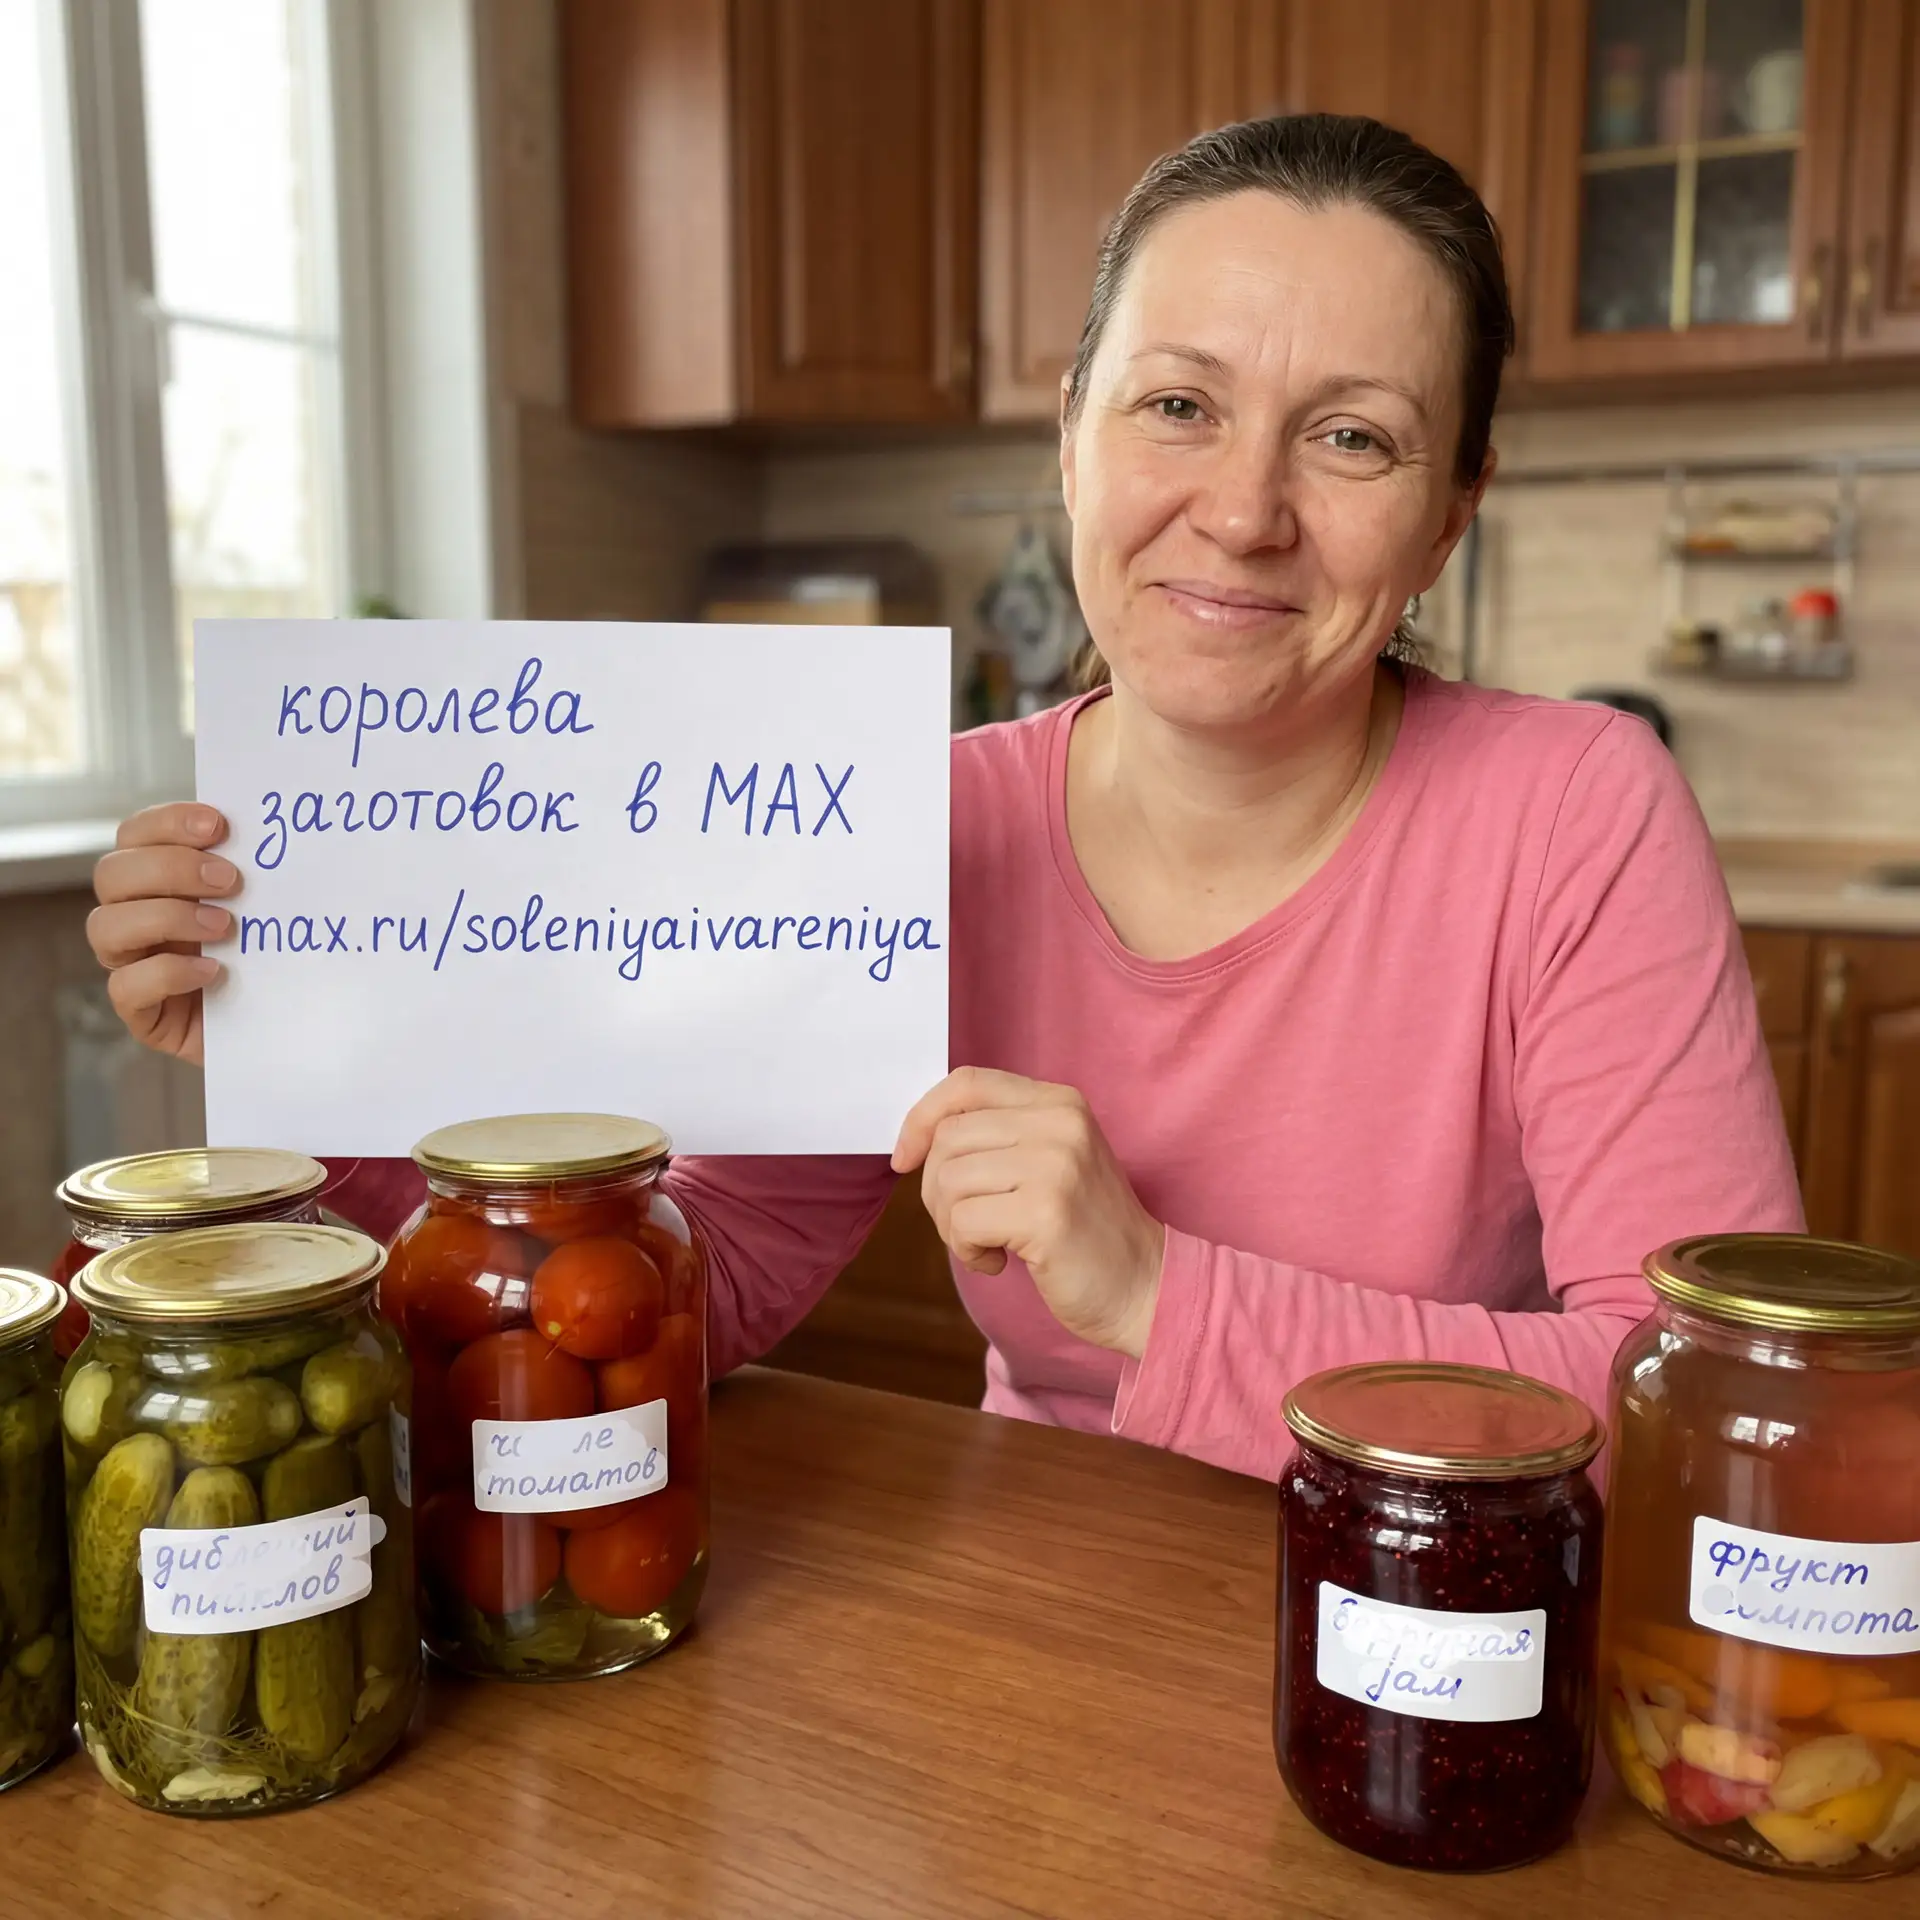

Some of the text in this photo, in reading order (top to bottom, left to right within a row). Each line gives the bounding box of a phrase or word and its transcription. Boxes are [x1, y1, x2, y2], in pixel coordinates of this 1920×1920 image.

[279, 657, 594, 767] королева
[255, 761, 579, 870] заготовок
[626, 761, 662, 834] в
[241, 889, 941, 982] max.ru/soleniyaivareniya
[487, 1447, 657, 1497] томатов
[1709, 1540, 1869, 1593] фрукт
